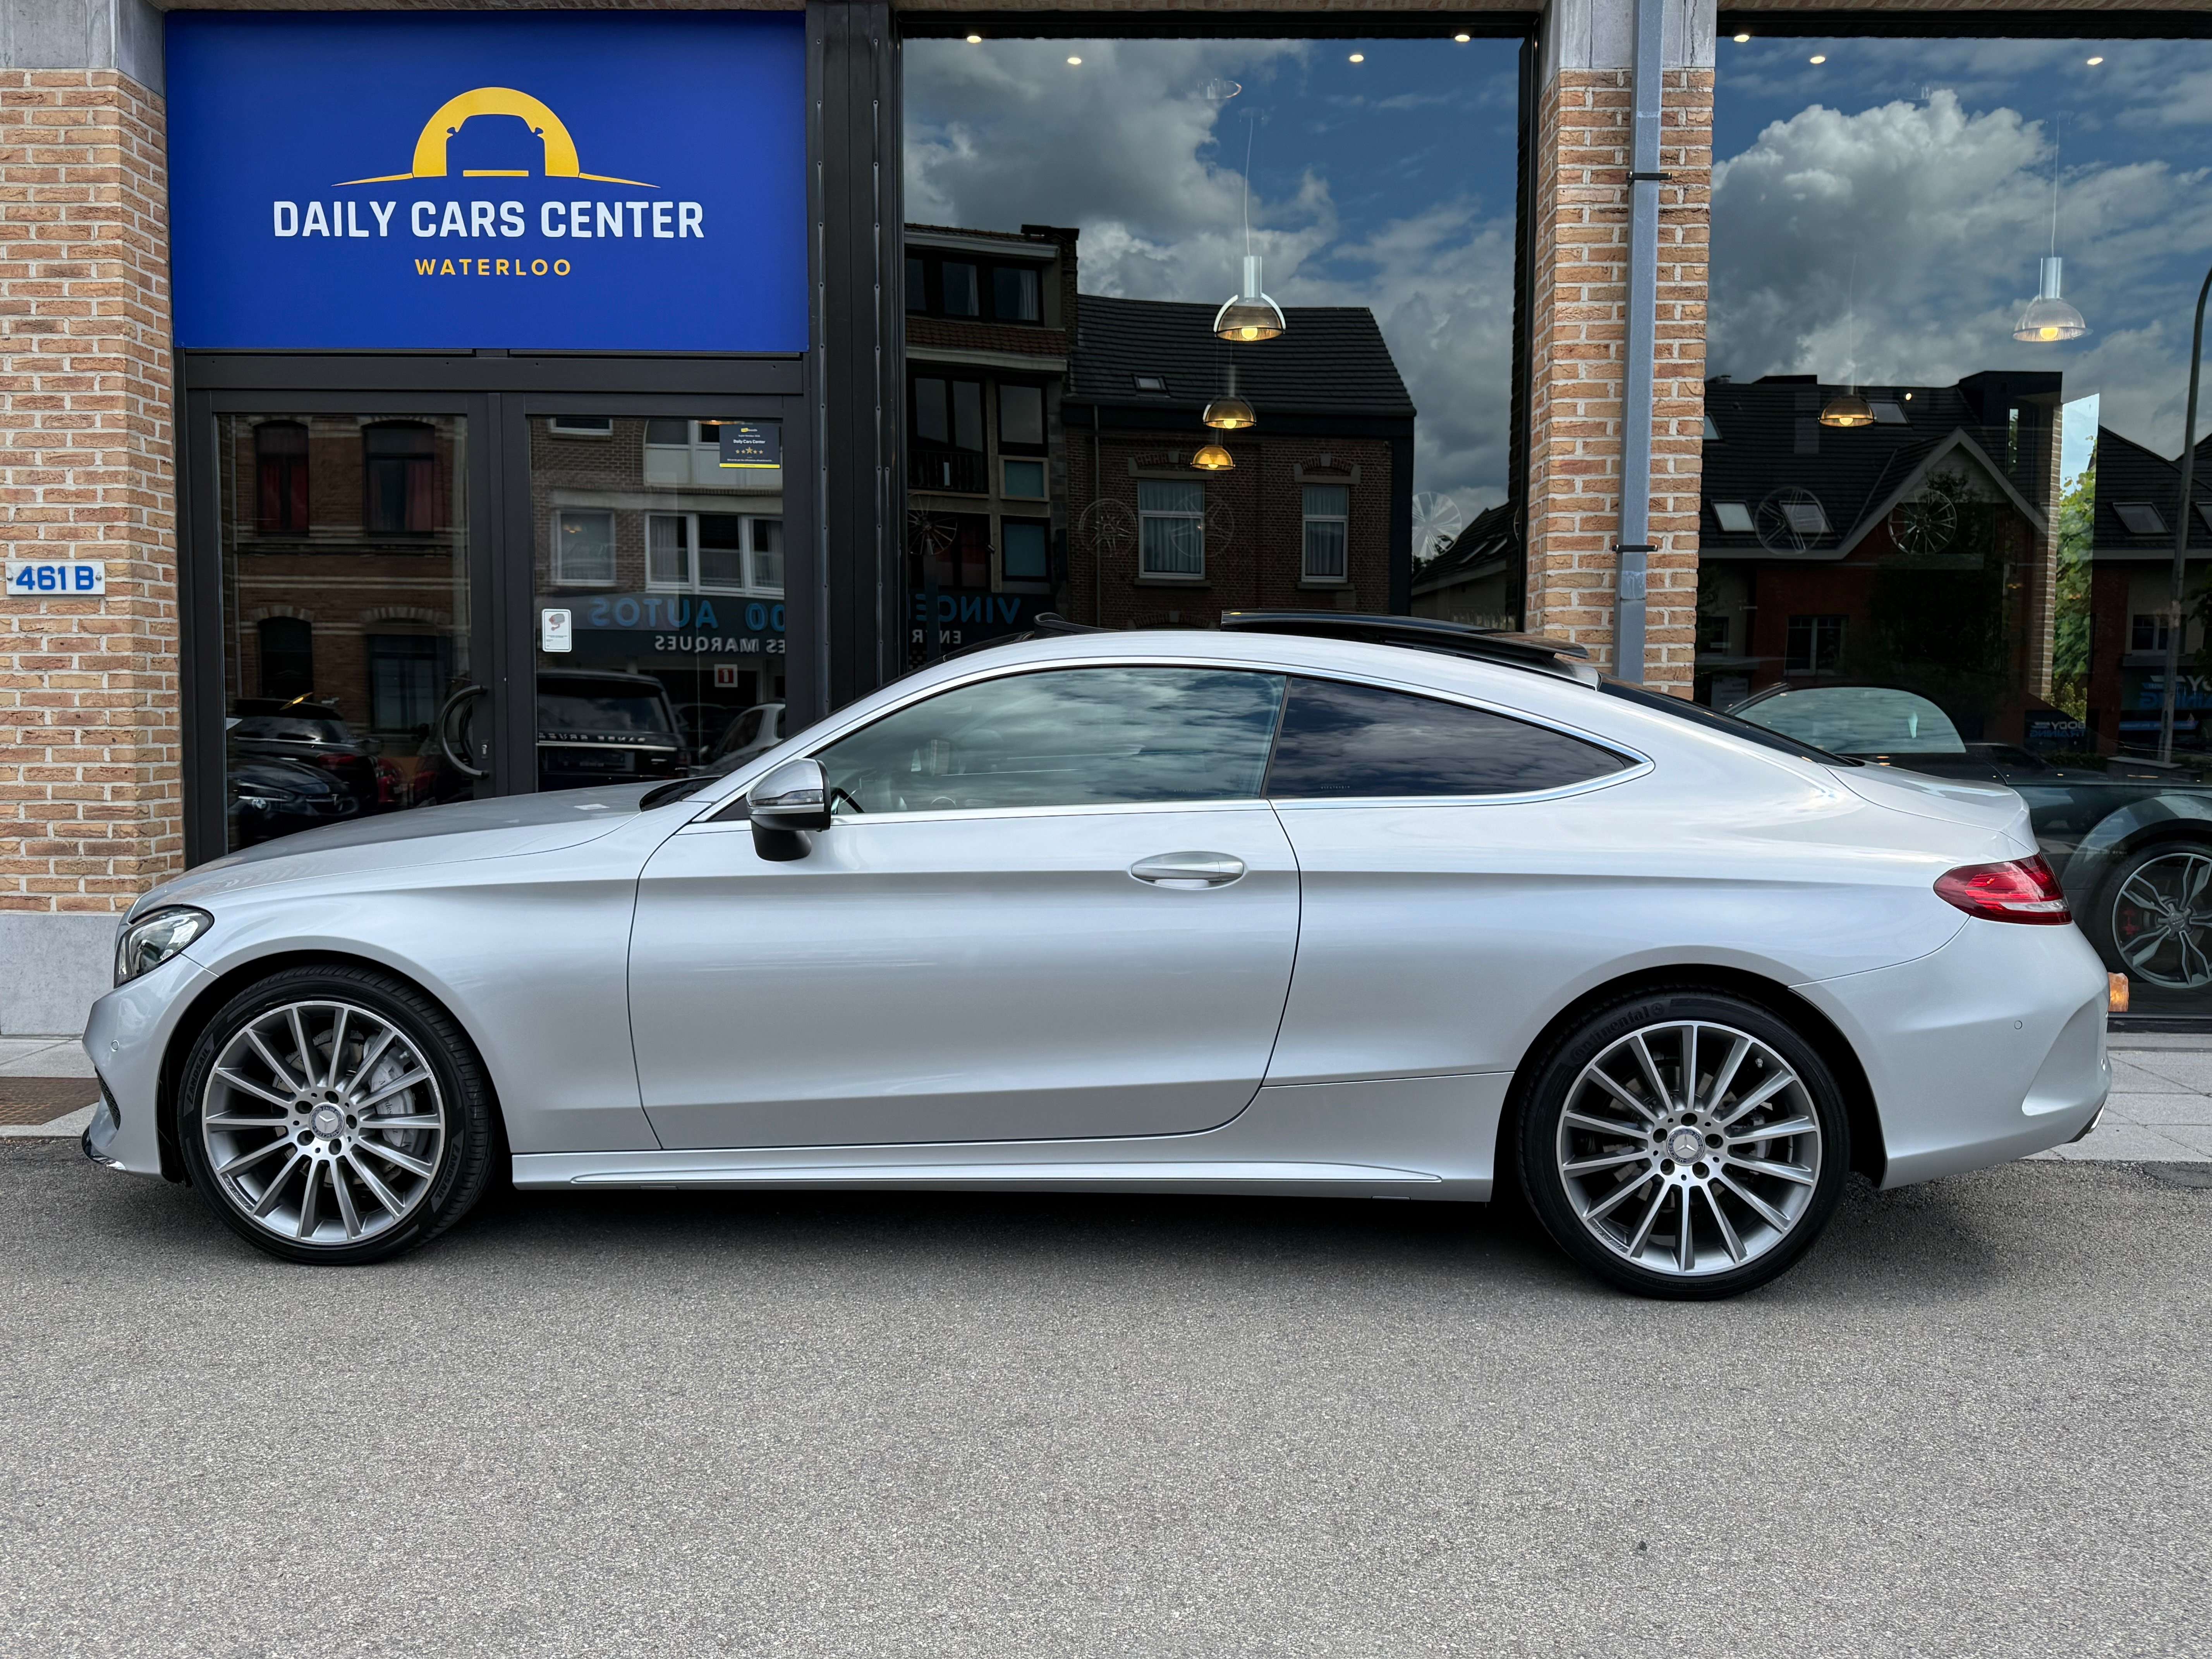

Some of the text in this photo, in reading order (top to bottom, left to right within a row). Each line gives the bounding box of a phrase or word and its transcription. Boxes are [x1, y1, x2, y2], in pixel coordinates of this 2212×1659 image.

[273, 201, 704, 238] DAILY CARS CENTER
[414, 258, 571, 276] WATERLOO
[16, 565, 94, 590] 461 B
[187, 1048, 210, 1104] LANDSAIL
[435, 1143, 460, 1199] LANDSAIL
